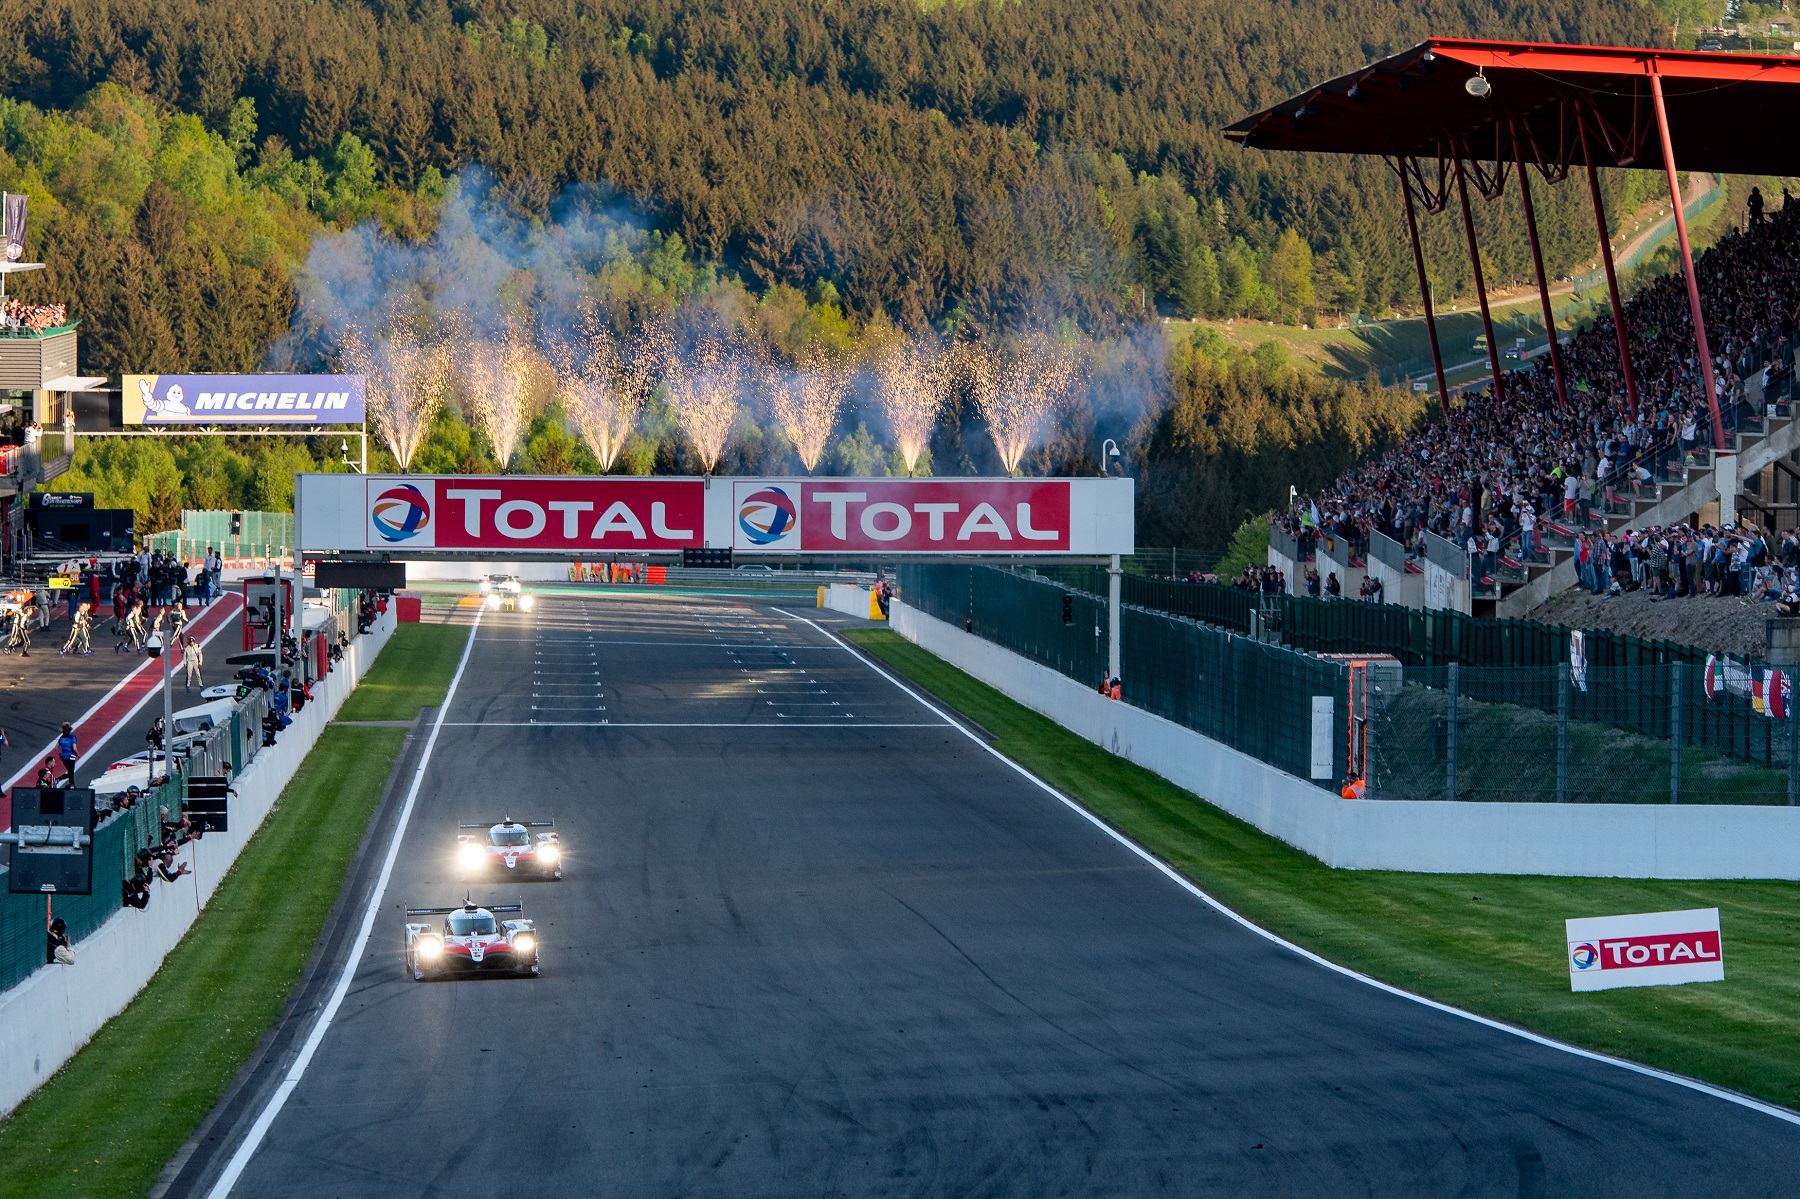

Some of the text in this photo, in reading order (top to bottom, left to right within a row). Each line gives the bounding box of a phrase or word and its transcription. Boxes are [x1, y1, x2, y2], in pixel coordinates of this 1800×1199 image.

[194, 392, 350, 410] MICHELIN
[446, 489, 694, 540] TOTAL
[812, 491, 1059, 542] TOTAL
[1605, 941, 1716, 965] TOTAL
